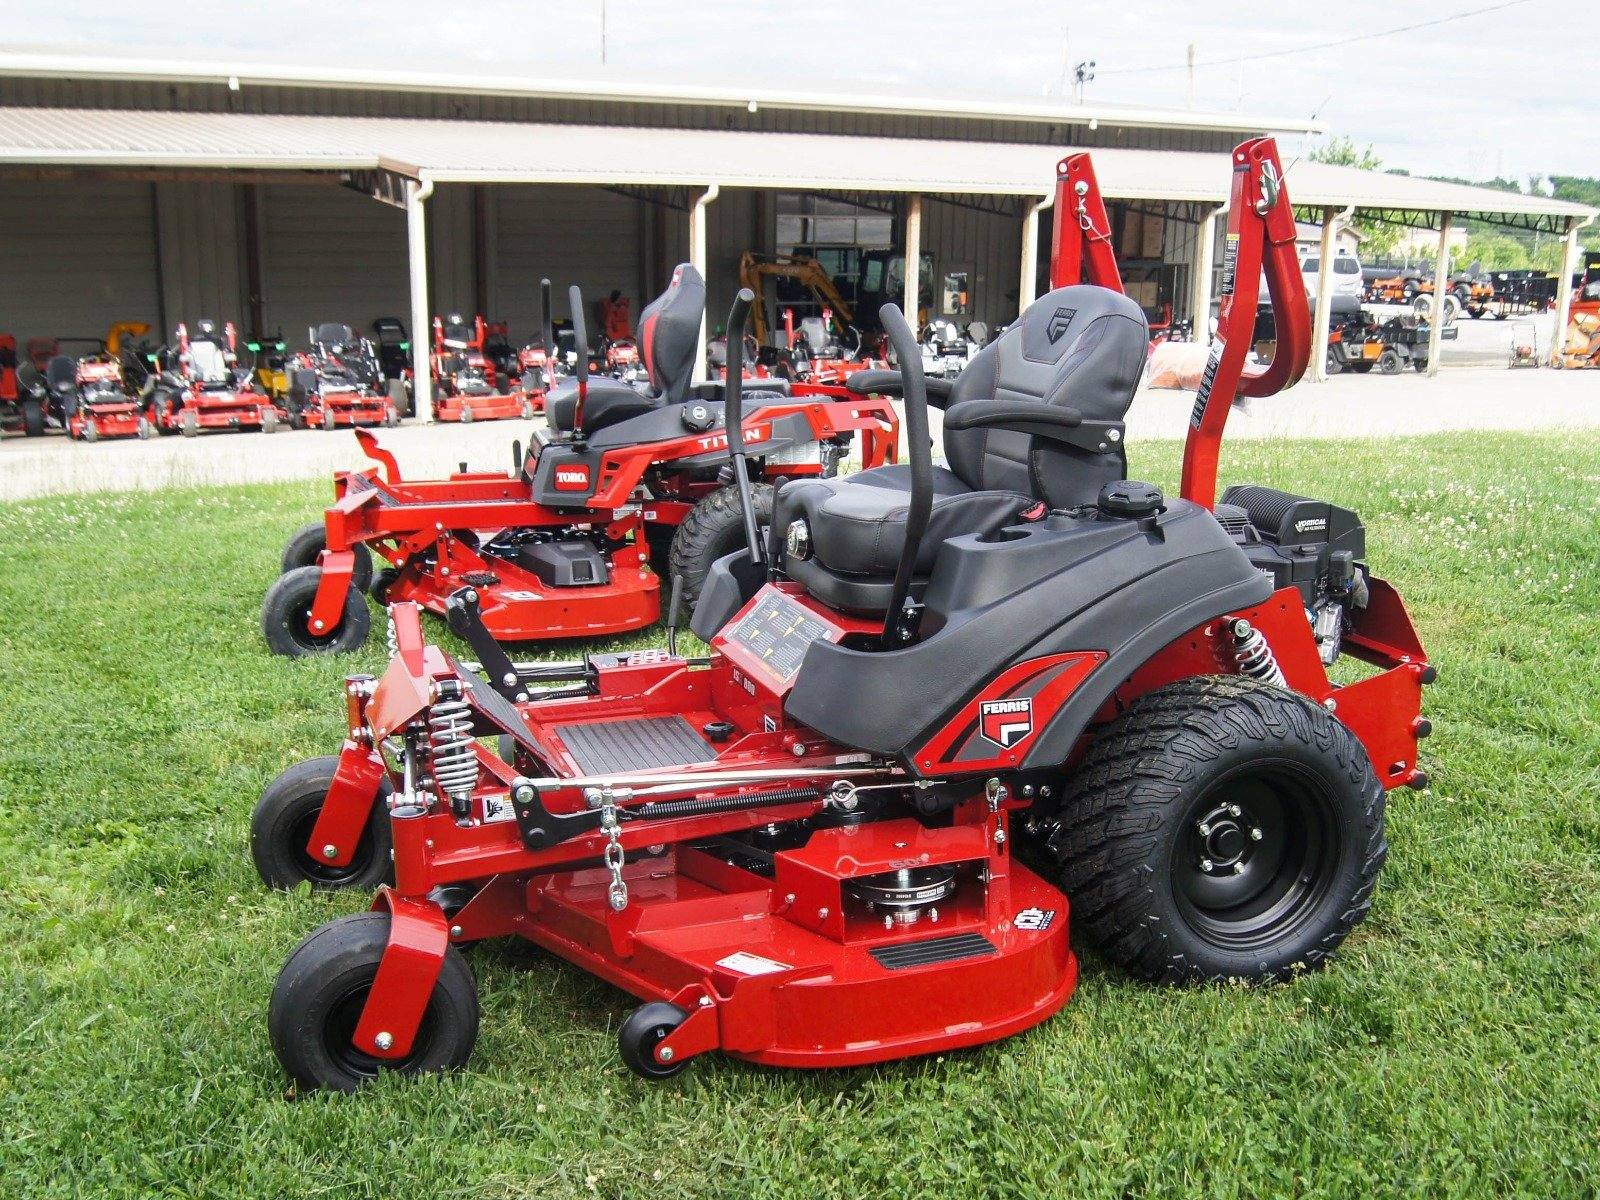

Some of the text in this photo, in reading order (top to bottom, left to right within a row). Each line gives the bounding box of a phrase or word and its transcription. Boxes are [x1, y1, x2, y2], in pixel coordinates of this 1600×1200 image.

[697, 428, 760, 450] TITN
[556, 472, 587, 483] TORO
[1297, 518, 1326, 527] VORTICAL
[983, 700, 1029, 714] FERRIS
